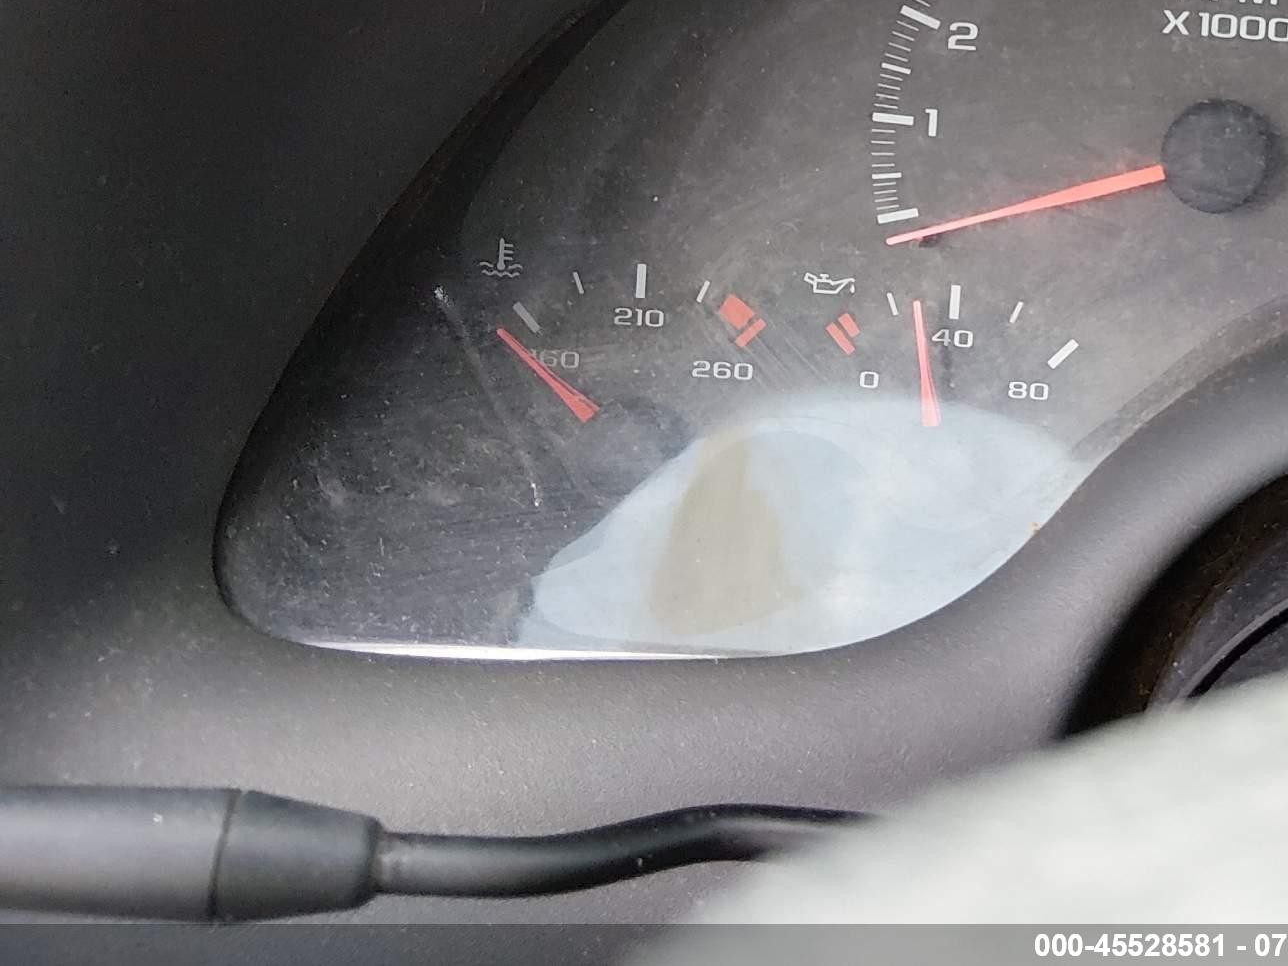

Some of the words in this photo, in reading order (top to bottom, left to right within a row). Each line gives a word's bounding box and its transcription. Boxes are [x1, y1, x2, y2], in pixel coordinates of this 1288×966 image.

[948, 23, 978, 50] 2
[926, 109, 937, 136] 1
[615, 308, 664, 327] 210
[932, 330, 973, 347] 40
[692, 361, 753, 380] 260
[860, 372, 879, 388] 0
[1009, 382, 1048, 400] 80
